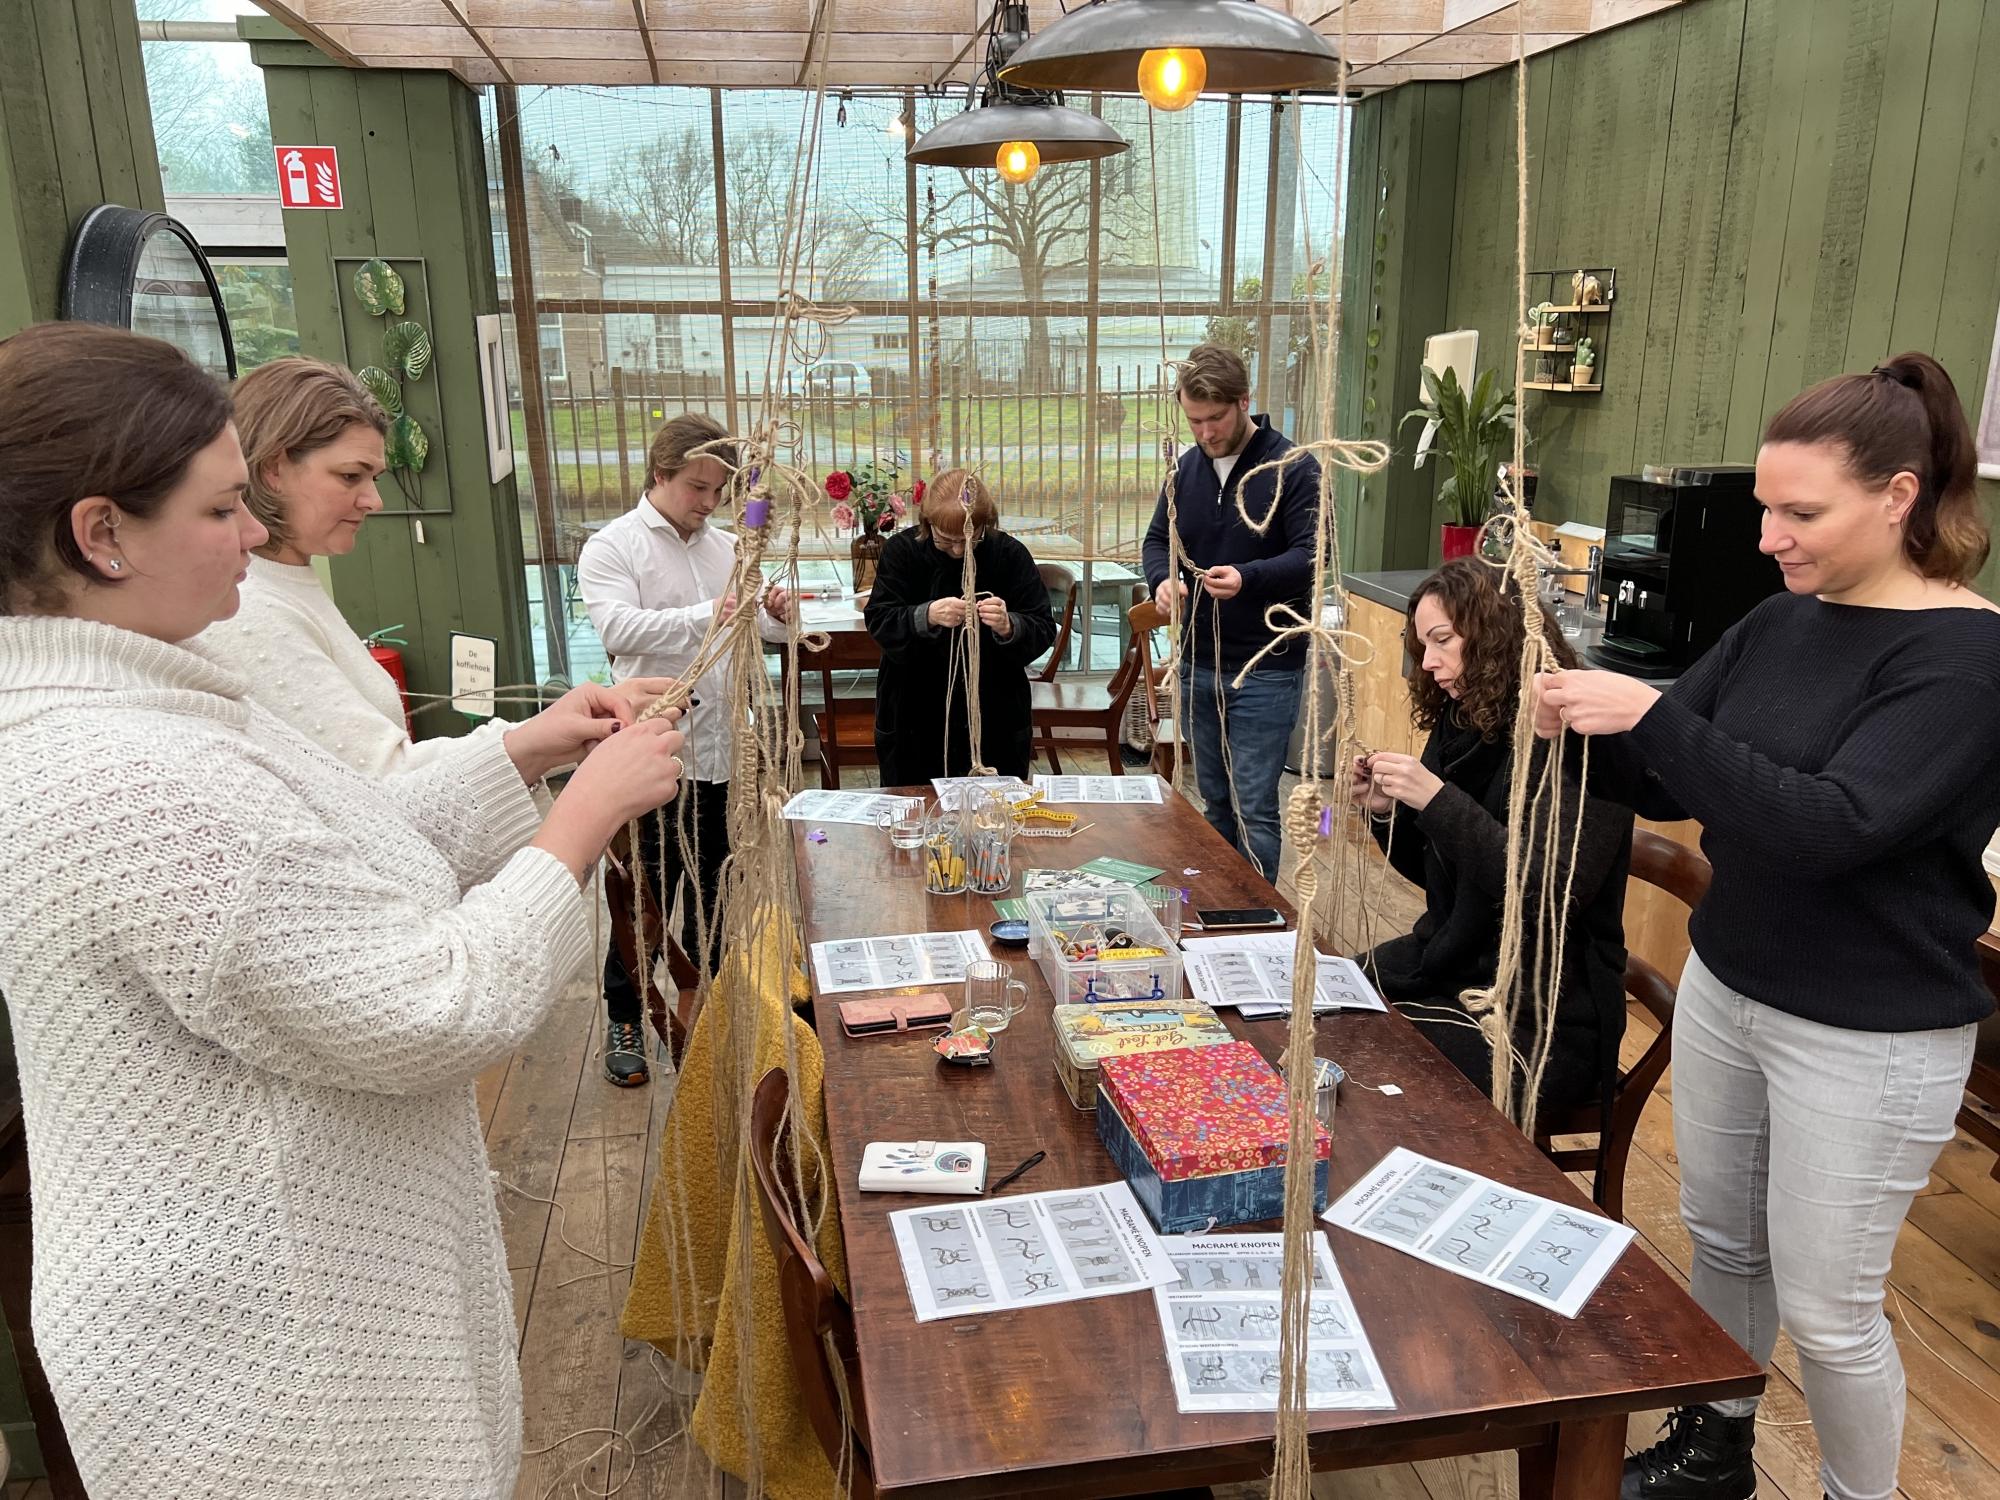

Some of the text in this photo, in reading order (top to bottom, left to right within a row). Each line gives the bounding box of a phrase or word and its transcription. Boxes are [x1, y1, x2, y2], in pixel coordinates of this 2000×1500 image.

[468, 650, 478, 658] De
[456, 660, 491, 672] koffiehoek
[1116, 1030, 1188, 1049] Get Lost
[1133, 1233, 1152, 1258] KNOPEN
[1192, 1240, 1281, 1249] MACRAMÉ KNOPEN
